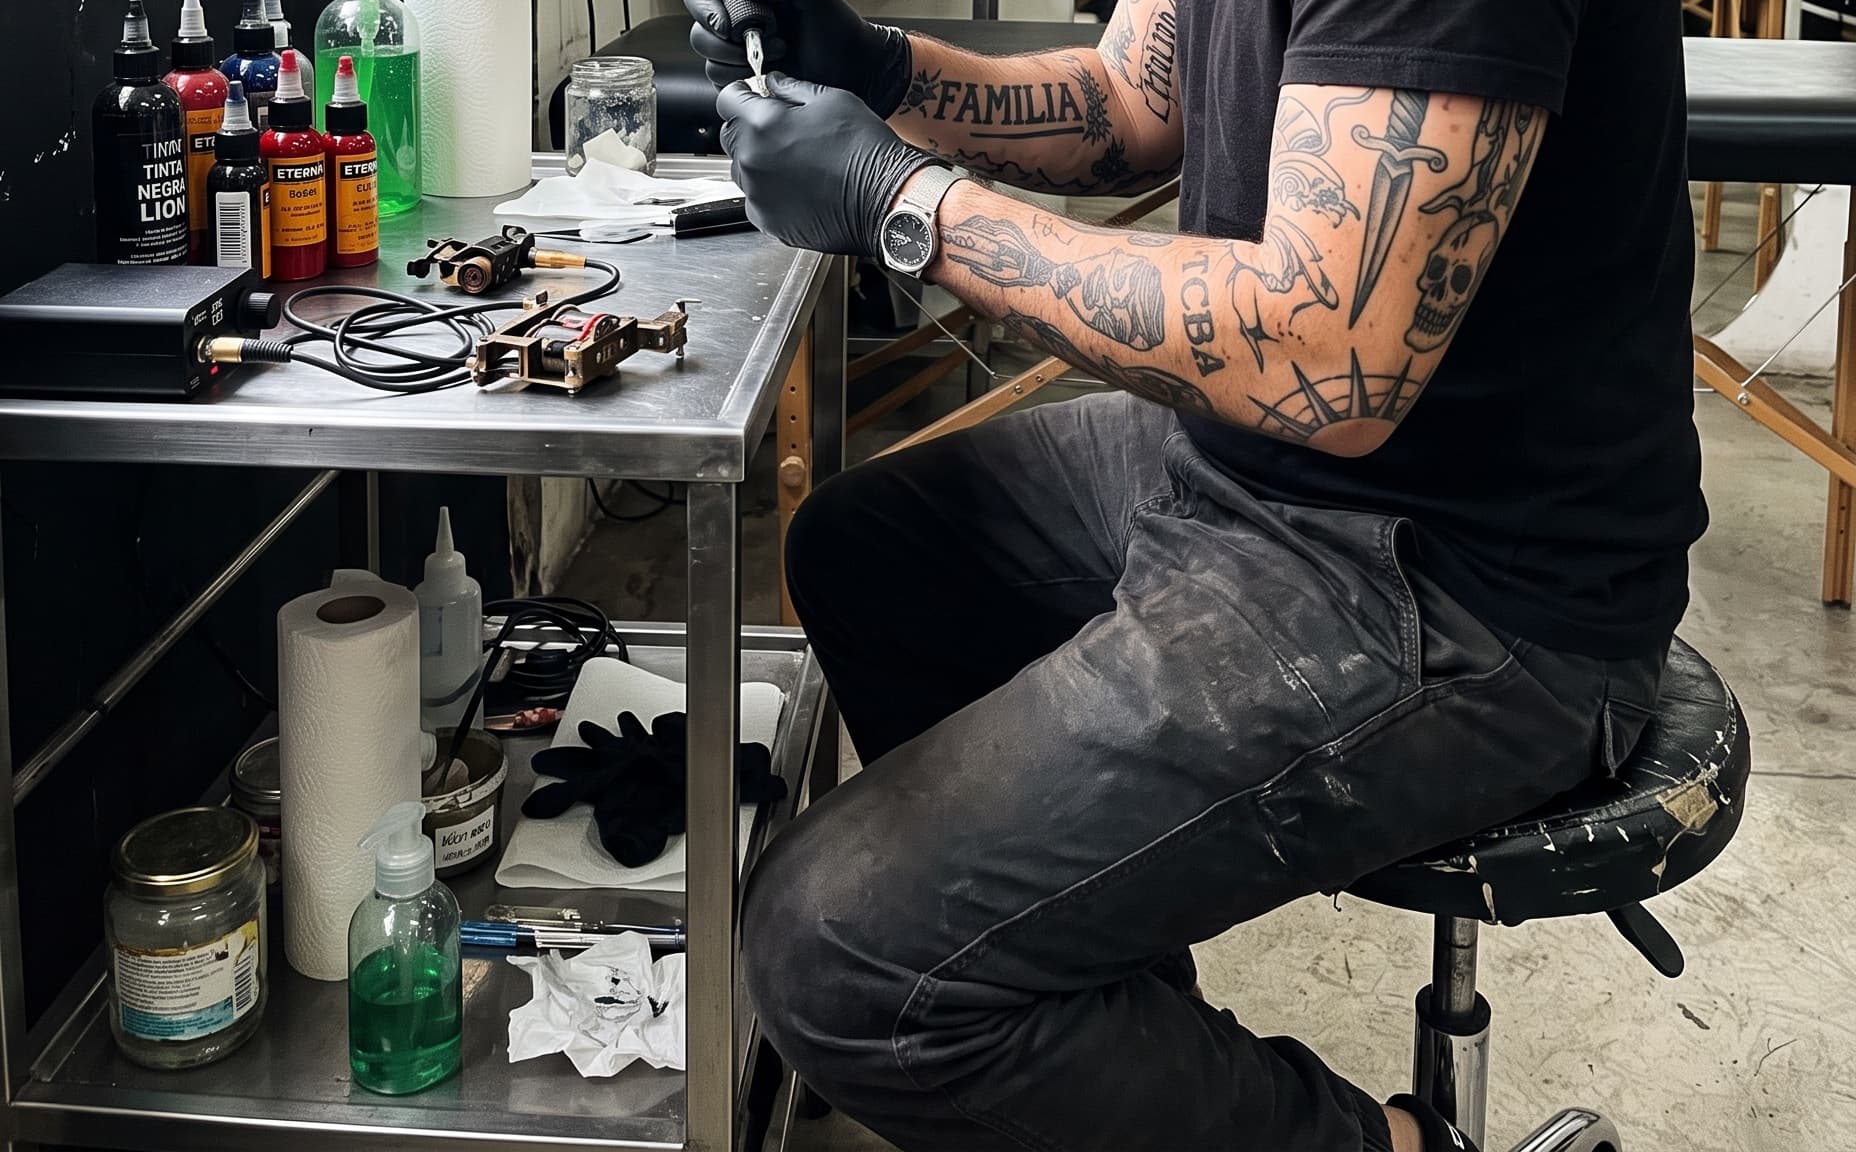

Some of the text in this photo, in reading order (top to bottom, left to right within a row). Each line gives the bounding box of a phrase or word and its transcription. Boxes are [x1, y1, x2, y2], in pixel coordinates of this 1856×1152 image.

[934, 80, 1083, 127] FAMILIA
[143, 159, 183, 180] TINTA
[277, 163, 324, 180] ETERNA
[138, 177, 185, 200] NEGRA
[140, 194, 186, 222] LION
